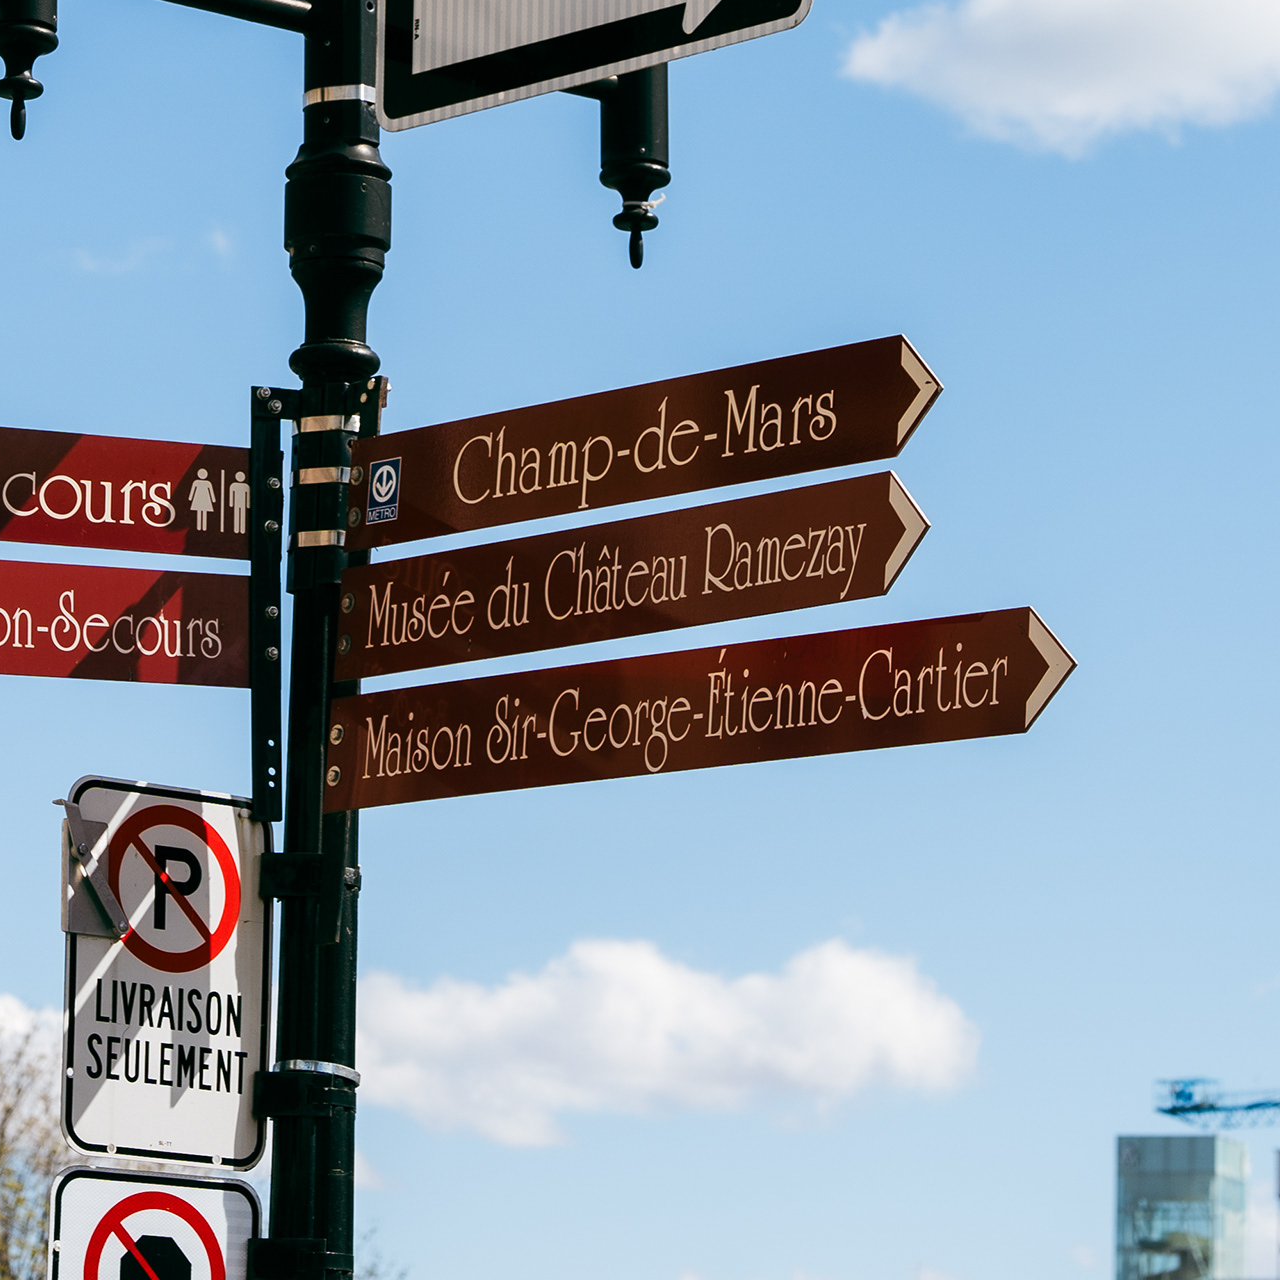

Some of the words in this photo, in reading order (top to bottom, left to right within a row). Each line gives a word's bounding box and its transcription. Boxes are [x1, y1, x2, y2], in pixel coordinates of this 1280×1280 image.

[453, 385, 837, 509] Champ-de-Mars
[365, 571, 475, 649] Musée
[487, 555, 530, 629] du
[545, 541, 687, 621] Château
[701, 523, 867, 600] Ramezay
[362, 712, 471, 779] Maison
[486, 642, 1008, 773] Sir-George-Étienne-Cartier
[153, 844, 202, 930] P
[96, 978, 242, 1038] LIVRAISON
[86, 1033, 248, 1095] SEULEMENT
